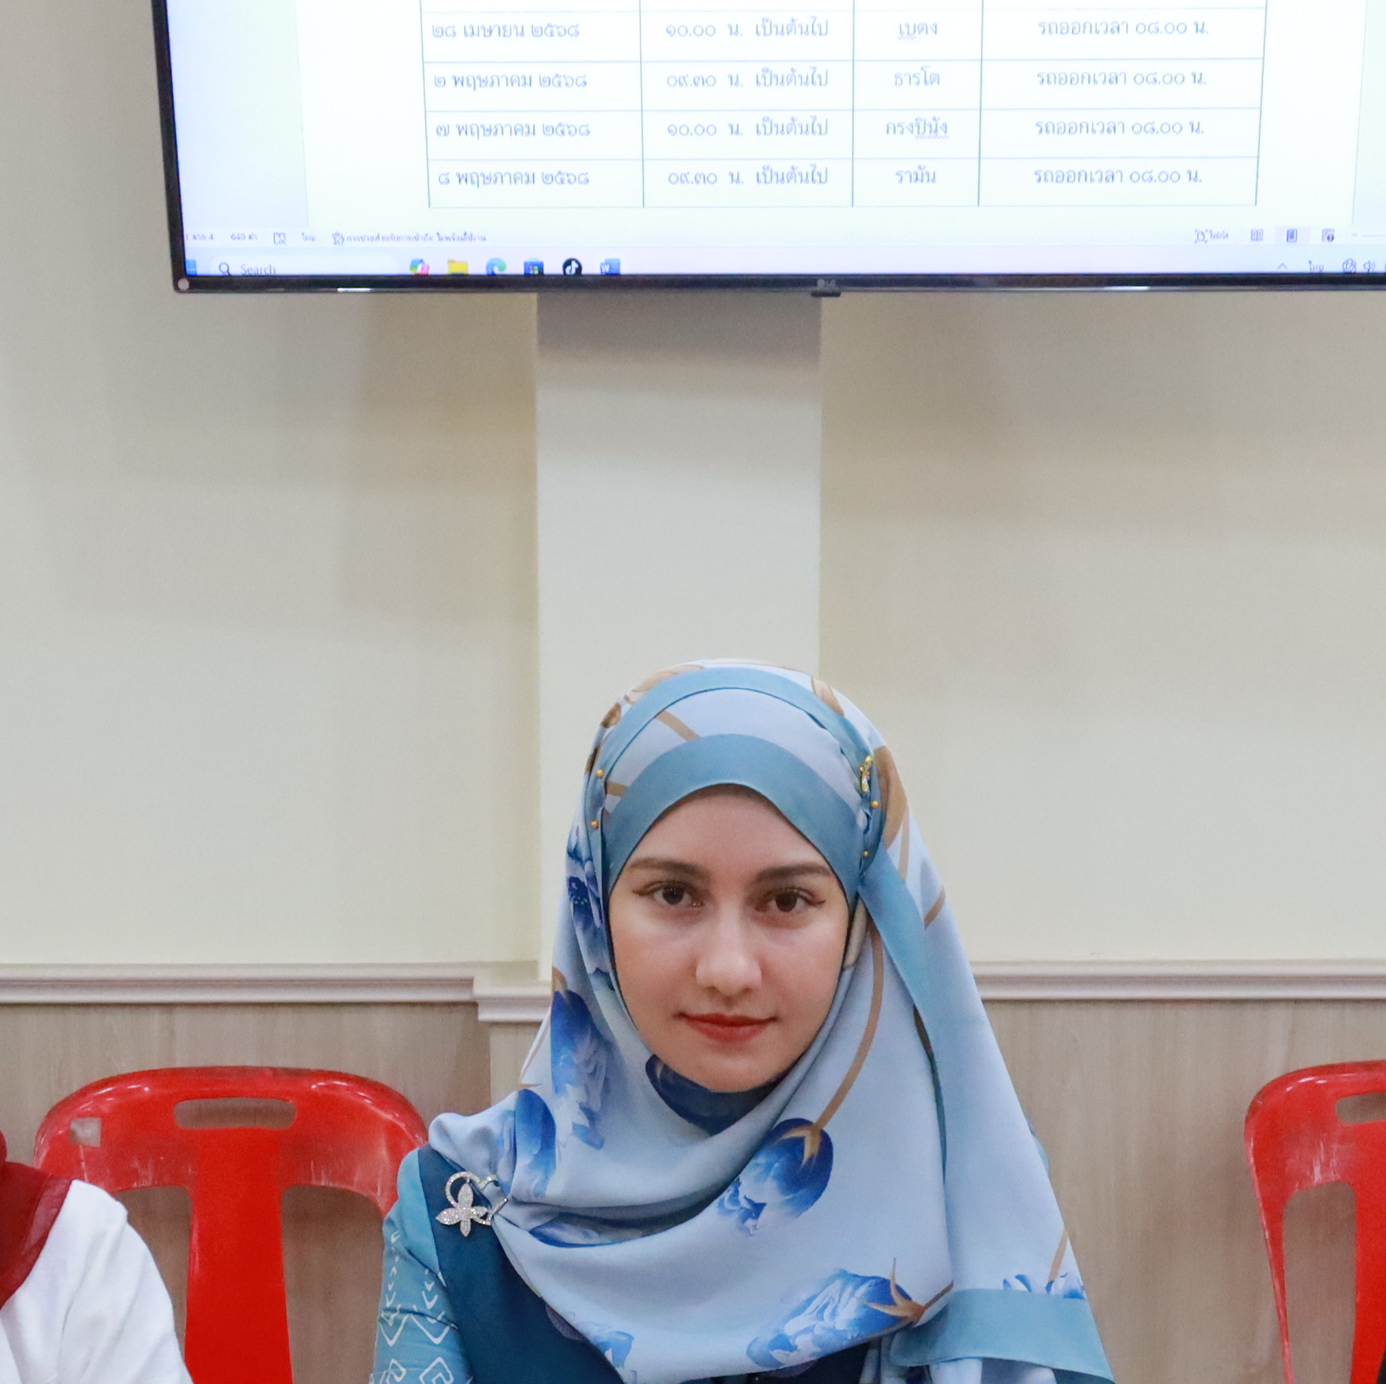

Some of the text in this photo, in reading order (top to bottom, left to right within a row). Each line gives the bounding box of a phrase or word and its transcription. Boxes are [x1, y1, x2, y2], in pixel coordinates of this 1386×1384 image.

[432, 23, 579, 38] ๒๘ เมษายน ๒๕๖๘
[666, 16, 829, 38] ๑๐.๐๐ น. เป็นต้นไป
[898, 22, 938, 37] เบตง
[1038, 21, 1128, 36] รถออกเวลา
[1193, 21, 1209, 34] น.
[434, 73, 587, 92] ๒ พฤษภาคม ๒๕๖๘
[667, 66, 829, 87] ๐๙.๓๐ น. เป็นต้นไป
[894, 65, 940, 86] ธารโต
[1037, 72, 1127, 86] รถออกเวลา
[1191, 72, 1206, 85] น.
[436, 122, 591, 140] ๗ พฤษภาคม ๒๕๖๘
[667, 115, 829, 136] ๑๐.๐๐ น. เป็นต้นไป
[886, 116, 948, 136] กรงปินัง
[1035, 121, 1125, 136] รถออกเวลา
[1189, 120, 1204, 134] น.
[438, 170, 590, 190] ๘ พฤษภาคม ๒๕๖๘
[668, 164, 829, 185] ๐๙.๓๐ น. เป็นต้นไป
[895, 166, 937, 184] รามัน
[1034, 169, 1123, 184] รถออกเวลา
[1186, 169, 1202, 183] น.
